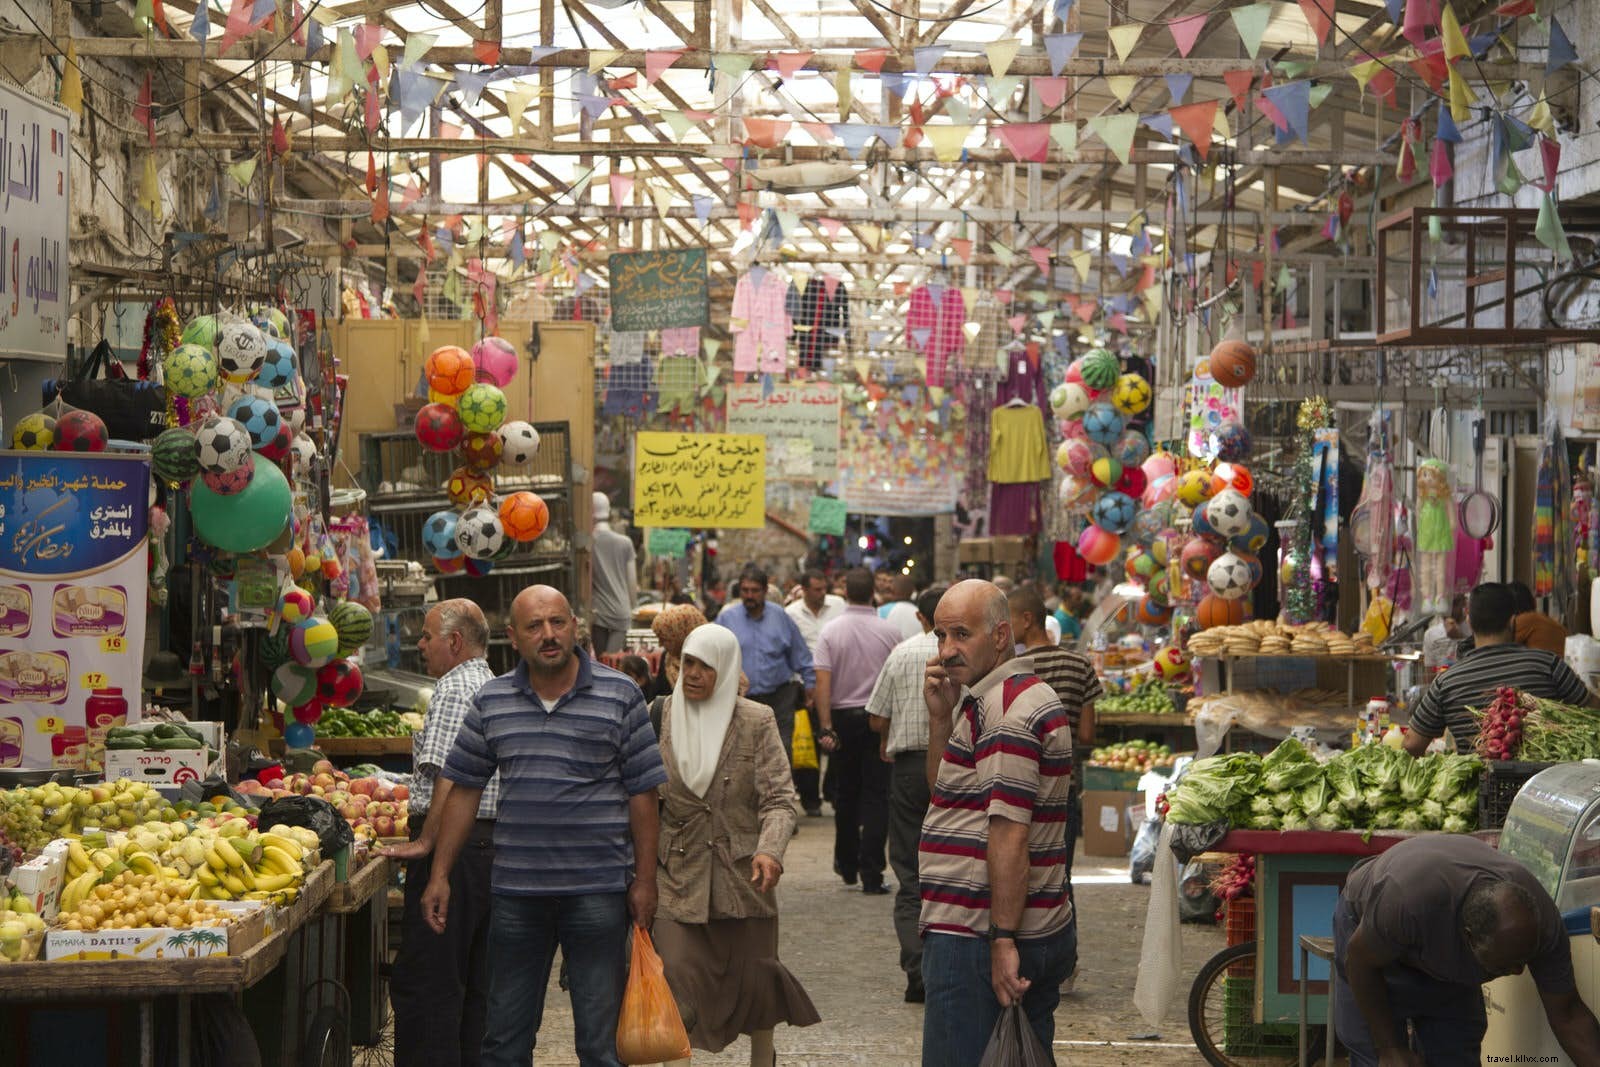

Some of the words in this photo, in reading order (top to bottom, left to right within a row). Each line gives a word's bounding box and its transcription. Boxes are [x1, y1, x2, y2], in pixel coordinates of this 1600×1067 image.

[717, 438, 759, 456] ملحمة
[27, 474, 58, 492] الخير
[61, 474, 88, 492] شهر
[91, 475, 127, 491] حملة
[89, 521, 132, 539] بالمفرق
[106, 638, 120, 648] 16
[87, 674, 101, 683] 17
[47, 718, 55, 728] 9
